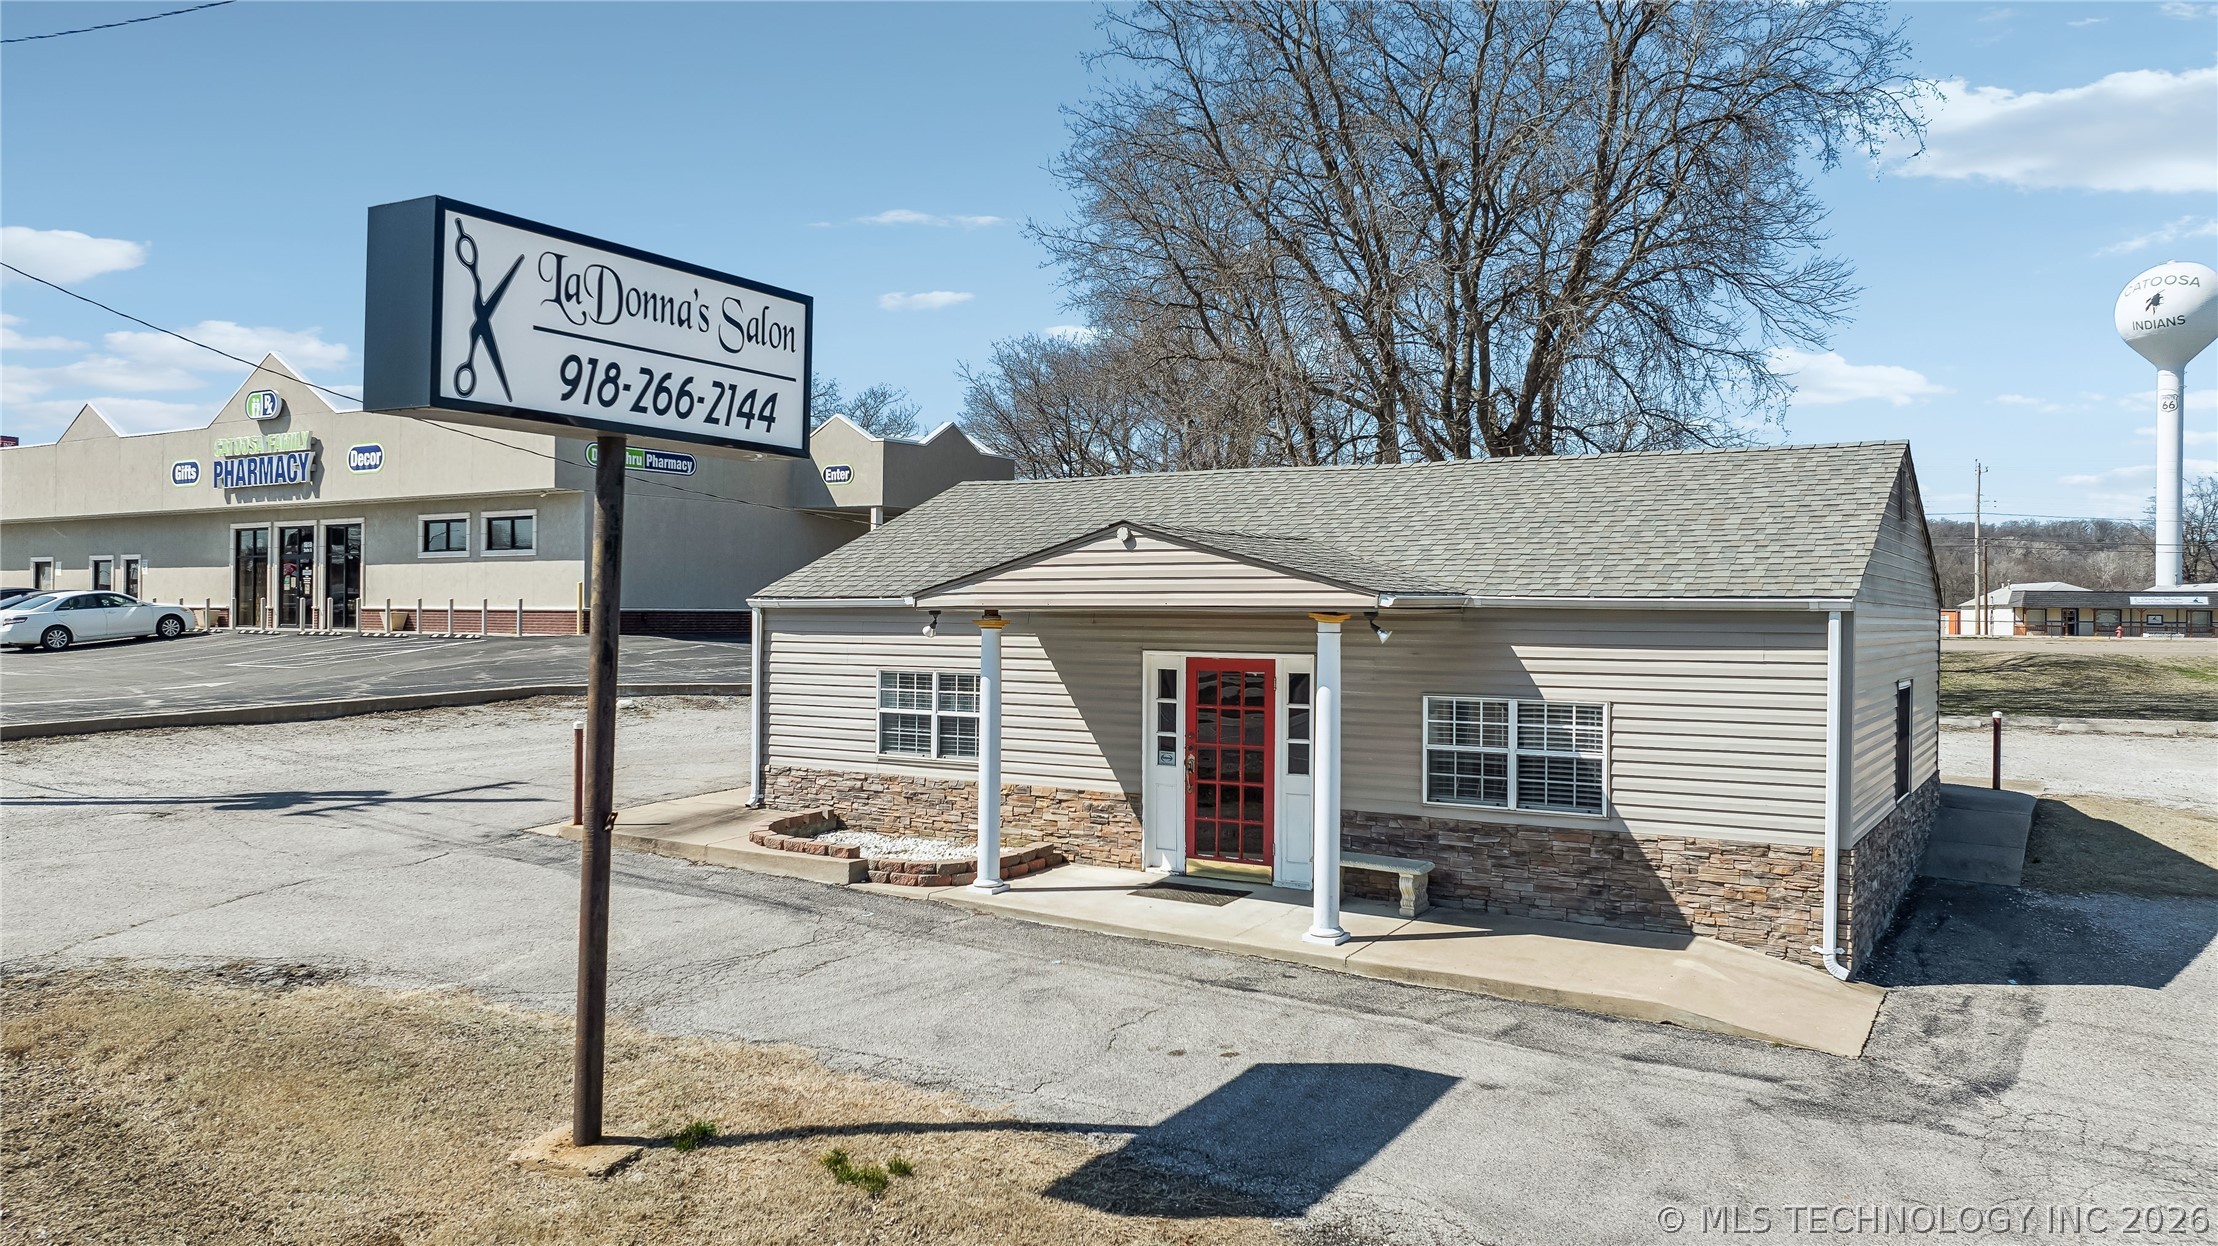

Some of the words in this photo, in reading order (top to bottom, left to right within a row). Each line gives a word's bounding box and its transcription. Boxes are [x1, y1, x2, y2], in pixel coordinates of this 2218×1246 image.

[2124, 275, 2200, 297] CATOOSA
[538, 251, 709, 333] LaDonna's
[718, 296, 796, 354] Salon
[2132, 315, 2186, 331] INDIANS
[560, 354, 778, 433] 918-266-2144
[2162, 401, 2176, 410] 66
[266, 431, 312, 452] FAMILY
[350, 448, 383, 467] Decor
[624, 451, 643, 466] hru
[646, 453, 693, 473] Pharmacy
[175, 465, 197, 480] Gifts
[213, 452, 311, 489] PHARMACY
[825, 468, 850, 482] Enter
